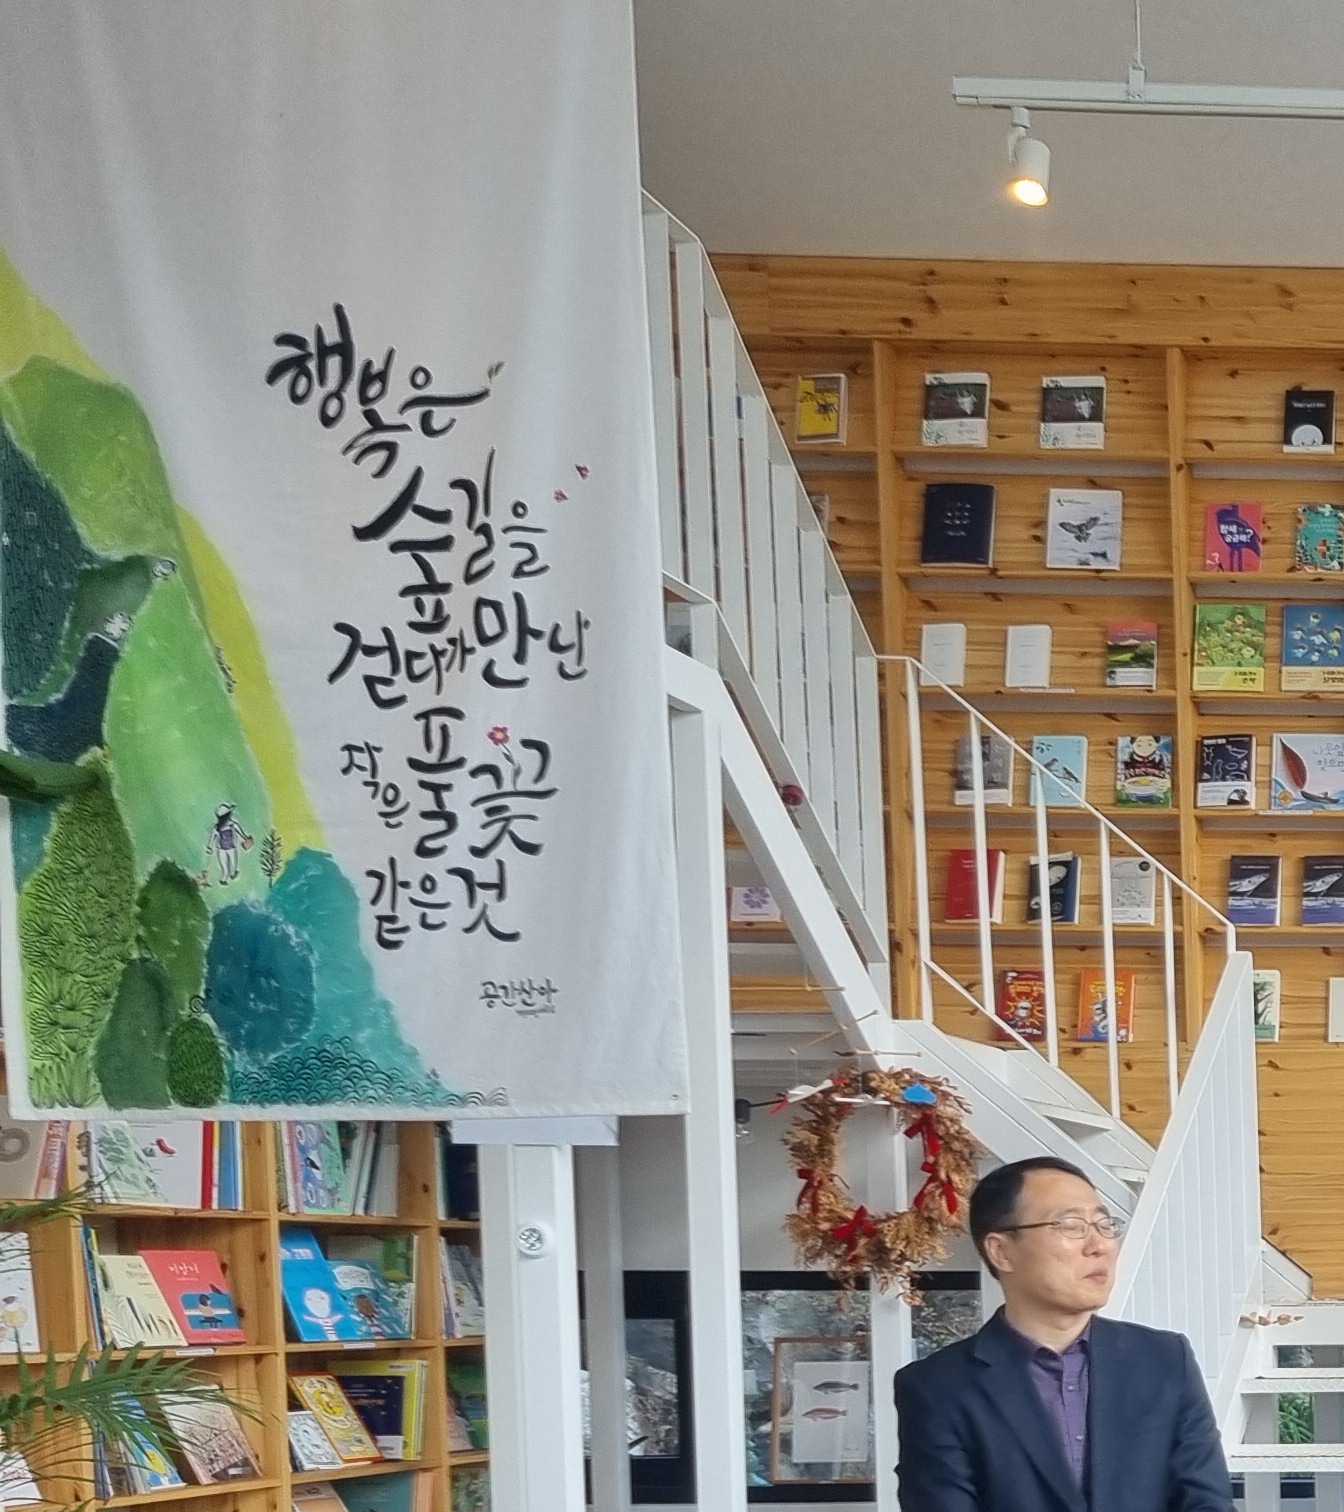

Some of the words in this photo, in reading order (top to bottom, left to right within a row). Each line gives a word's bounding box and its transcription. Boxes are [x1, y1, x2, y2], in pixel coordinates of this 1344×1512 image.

[265, 303, 490, 477] 행복은
[473, 592, 591, 688] 만난
[340, 741, 409, 830] 작은
